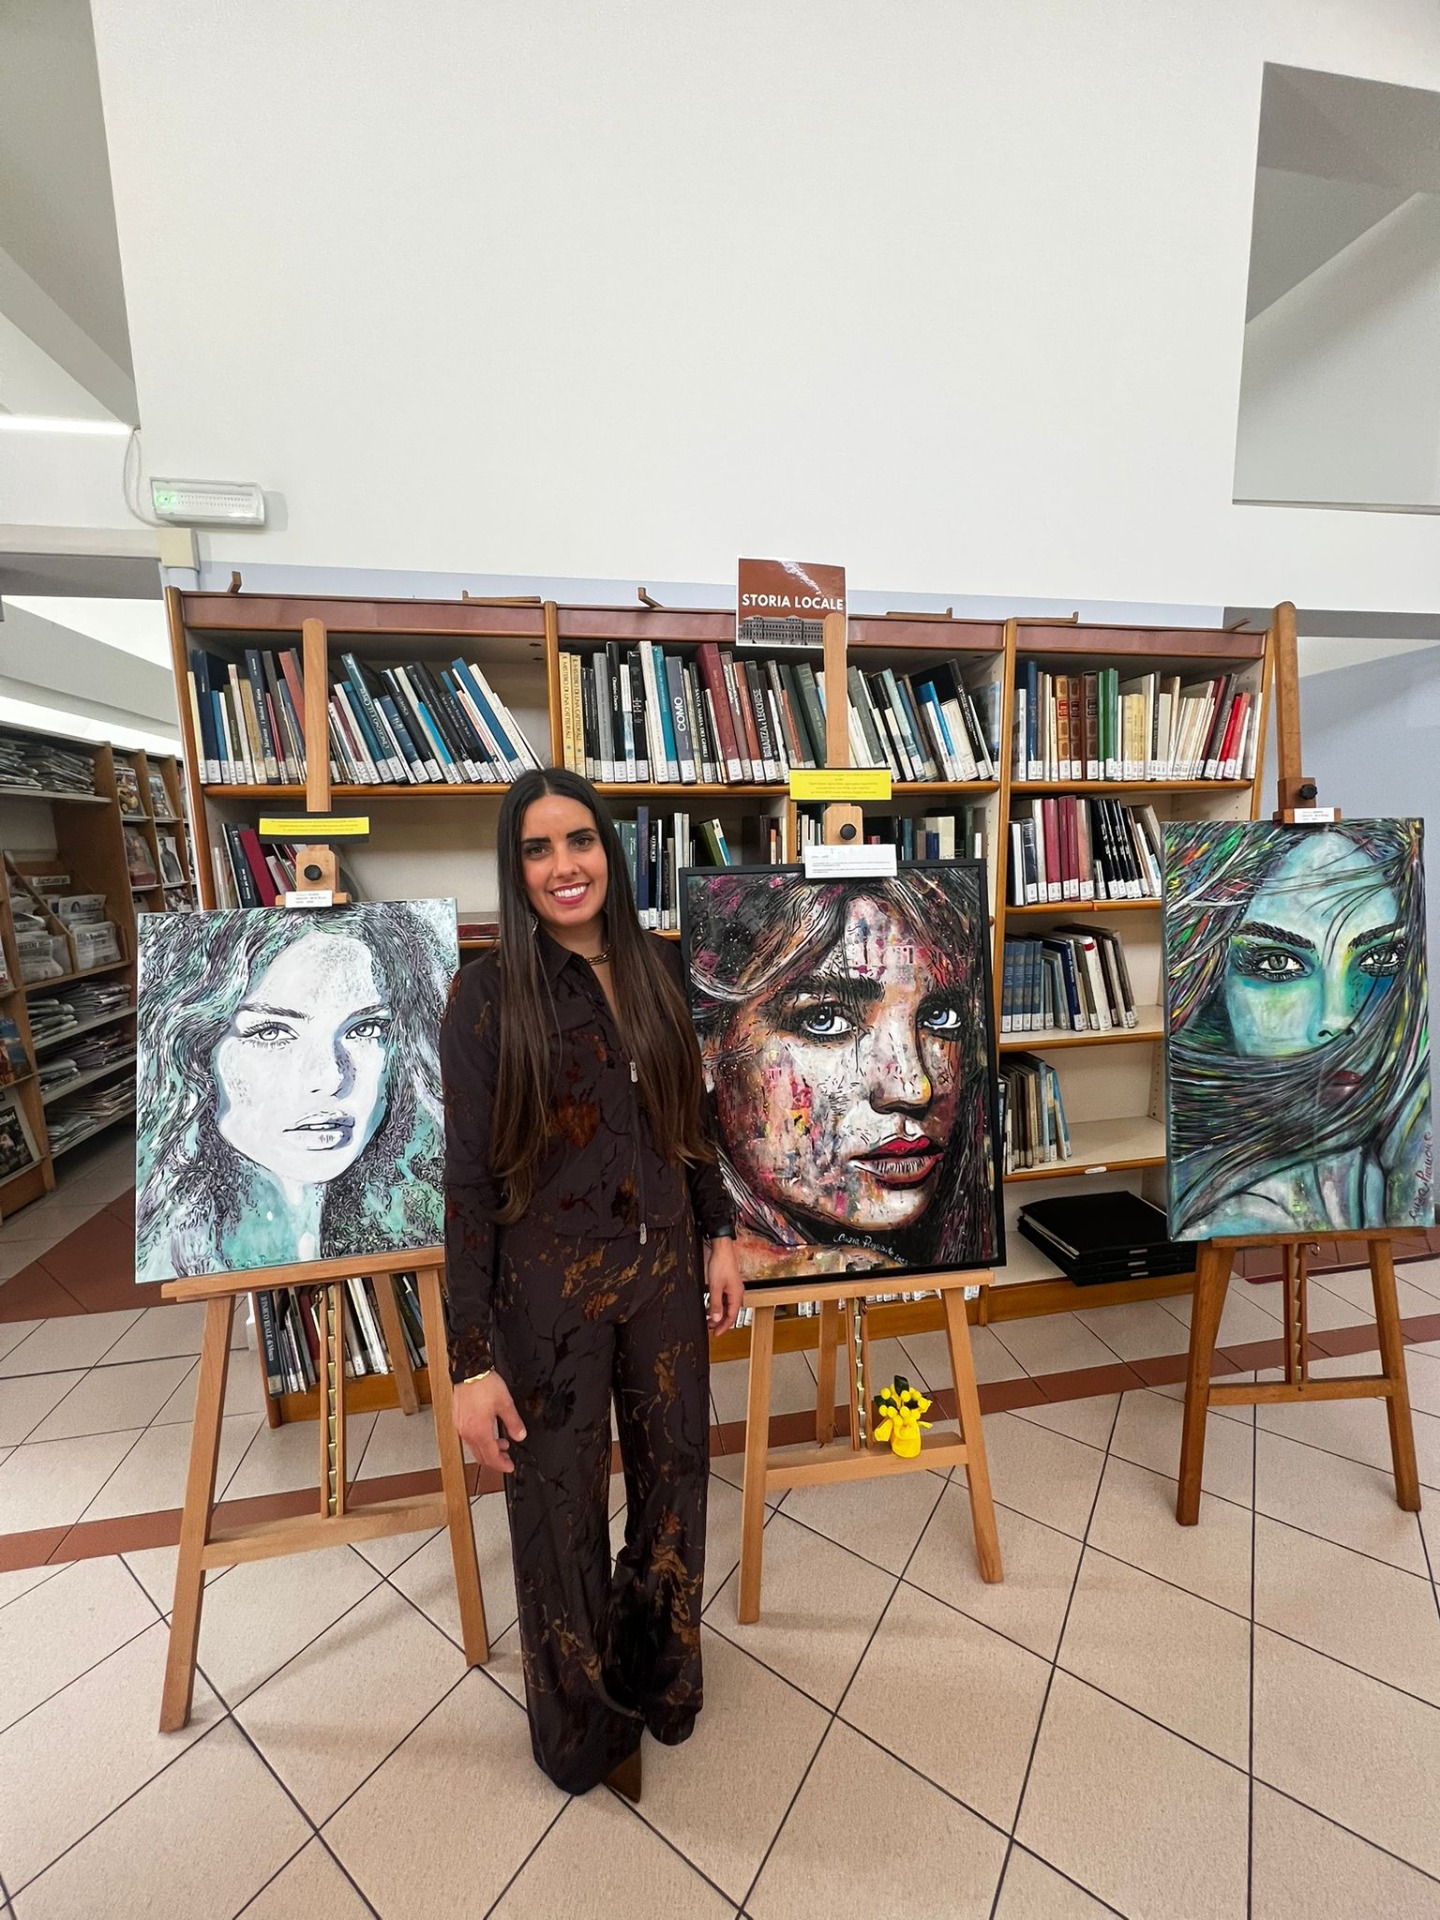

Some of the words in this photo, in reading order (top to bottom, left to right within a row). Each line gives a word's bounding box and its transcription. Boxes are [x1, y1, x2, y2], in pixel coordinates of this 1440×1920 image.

[742, 594, 791, 608] STORIA
[795, 596, 844, 610] LOCALE
[674, 696, 686, 731] COMO
[264, 1320, 272, 1338] REALE
